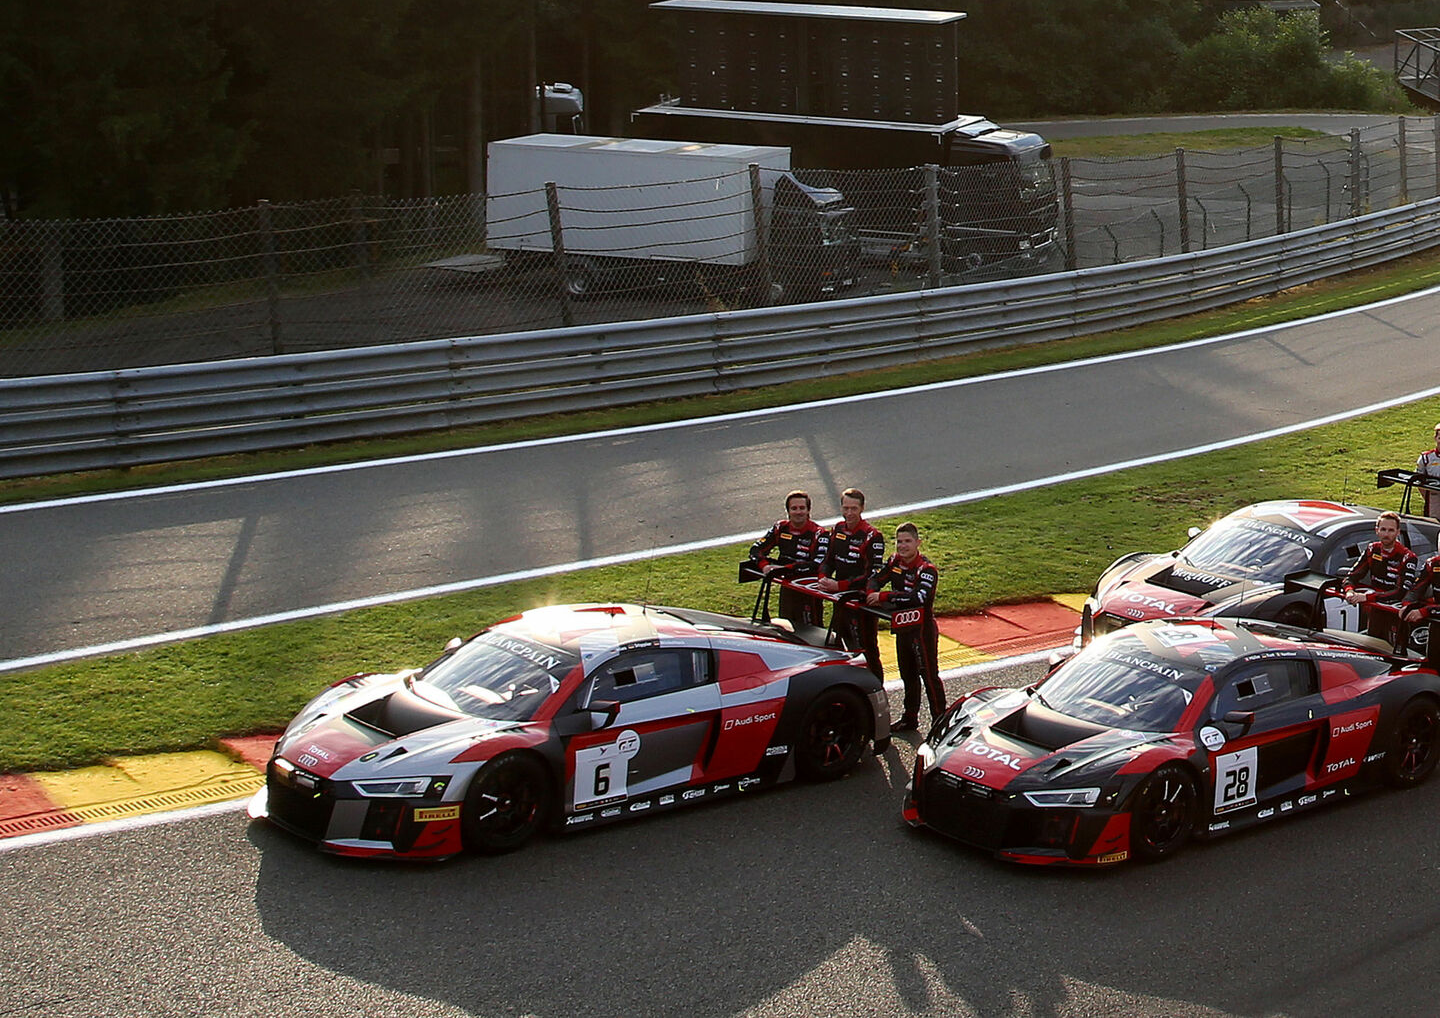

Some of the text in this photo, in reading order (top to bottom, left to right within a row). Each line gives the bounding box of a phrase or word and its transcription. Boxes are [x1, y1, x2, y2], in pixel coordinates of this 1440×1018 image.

[1244, 519, 1311, 545] BLANCPAIN
[1171, 567, 1233, 589] BergHOFF
[1115, 589, 1178, 616] TOTAL
[1340, 609, 1347, 631] 1
[1108, 650, 1185, 681] BLANCPAIN
[734, 712, 776, 727] Audi Sport
[1340, 719, 1373, 735] Audi Sport
[307, 744, 330, 760] TOTAL
[964, 739, 1022, 771] TOTAL
[1326, 757, 1357, 773] TOTAL
[593, 762, 611, 797] 6
[1223, 765, 1251, 803] 28
[418, 808, 457, 820] PIRELLI
